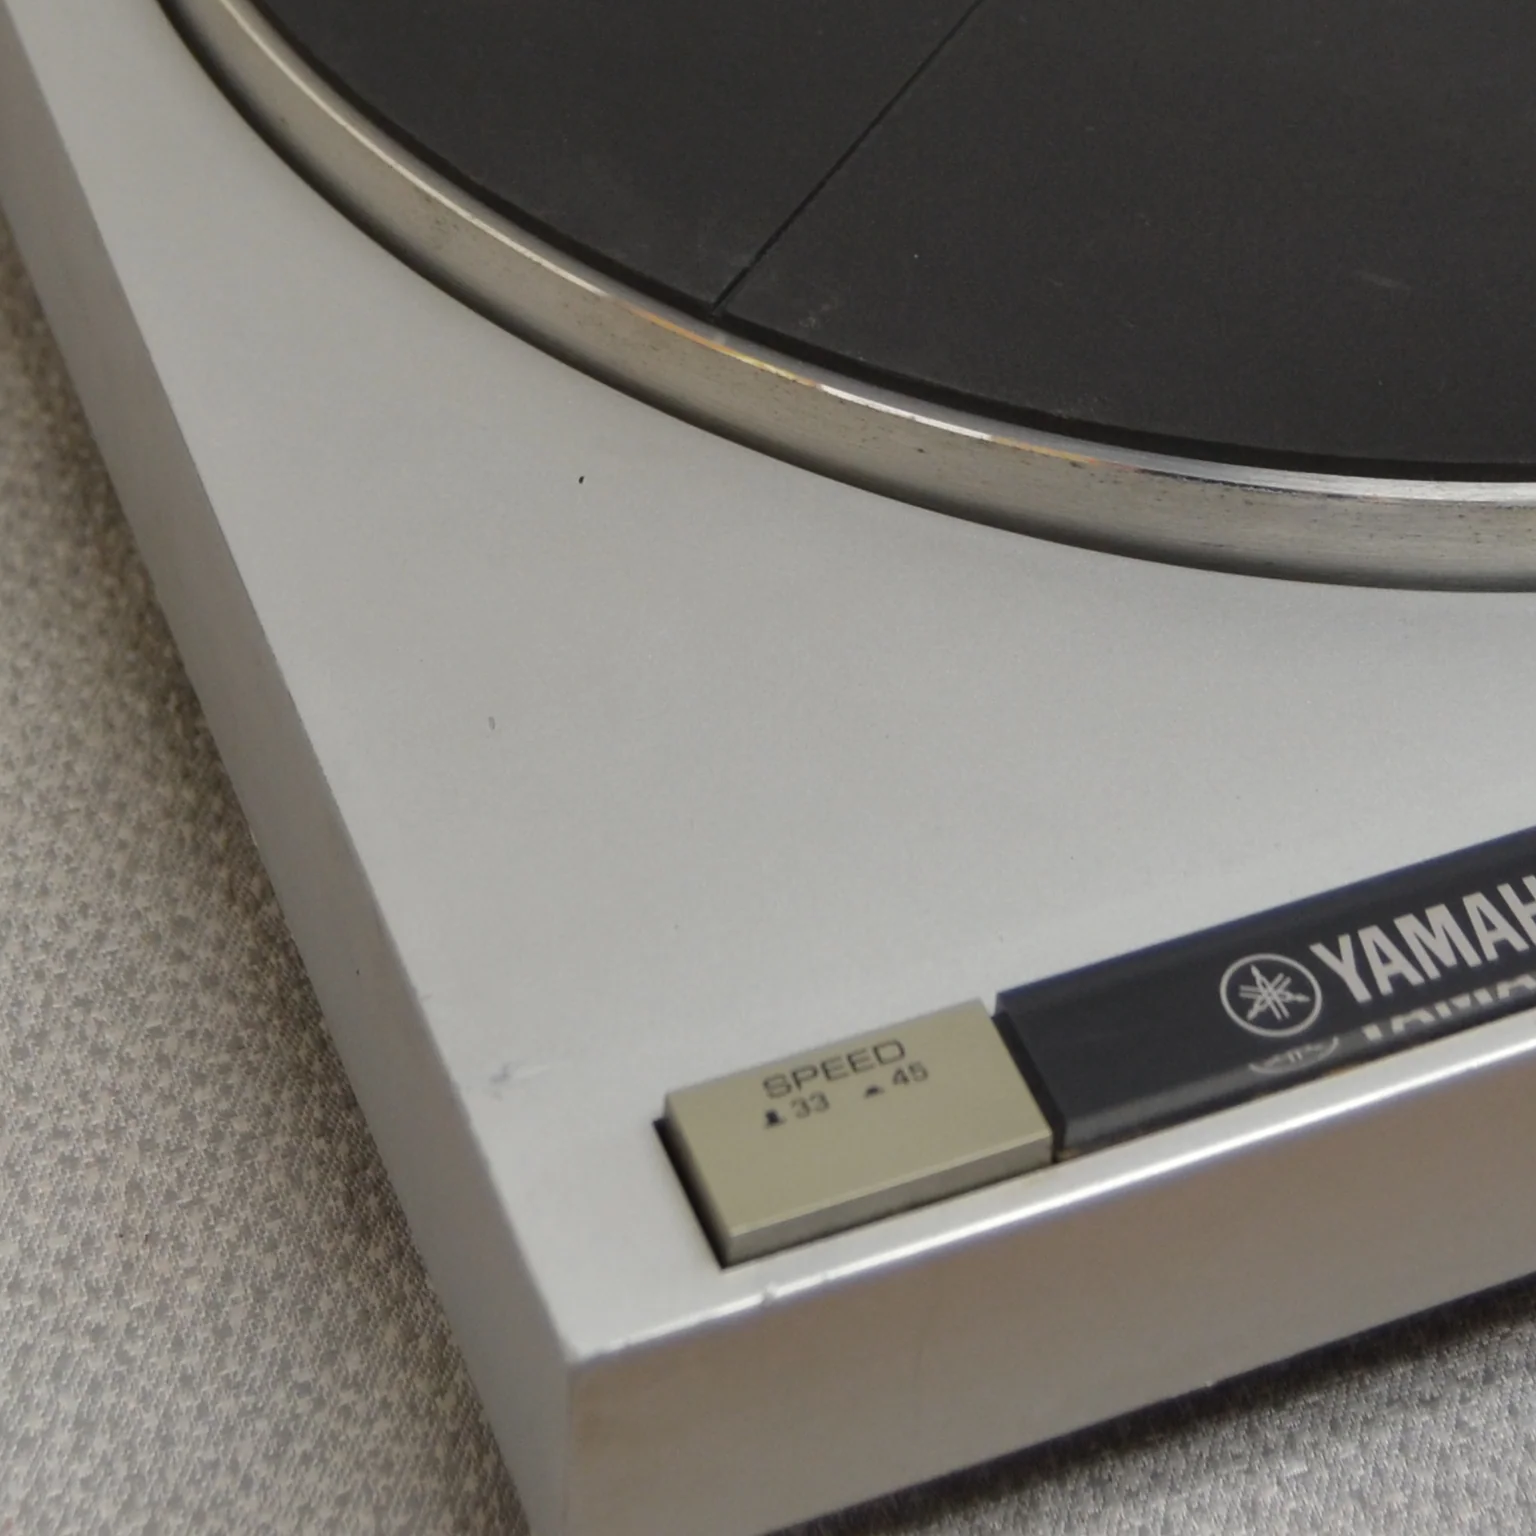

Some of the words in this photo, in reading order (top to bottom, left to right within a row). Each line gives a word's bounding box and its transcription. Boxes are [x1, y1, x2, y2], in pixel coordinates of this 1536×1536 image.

[763, 1039, 906, 1099] SPEED
[790, 1091, 830, 1119] 33
[892, 1061, 929, 1086] 45
